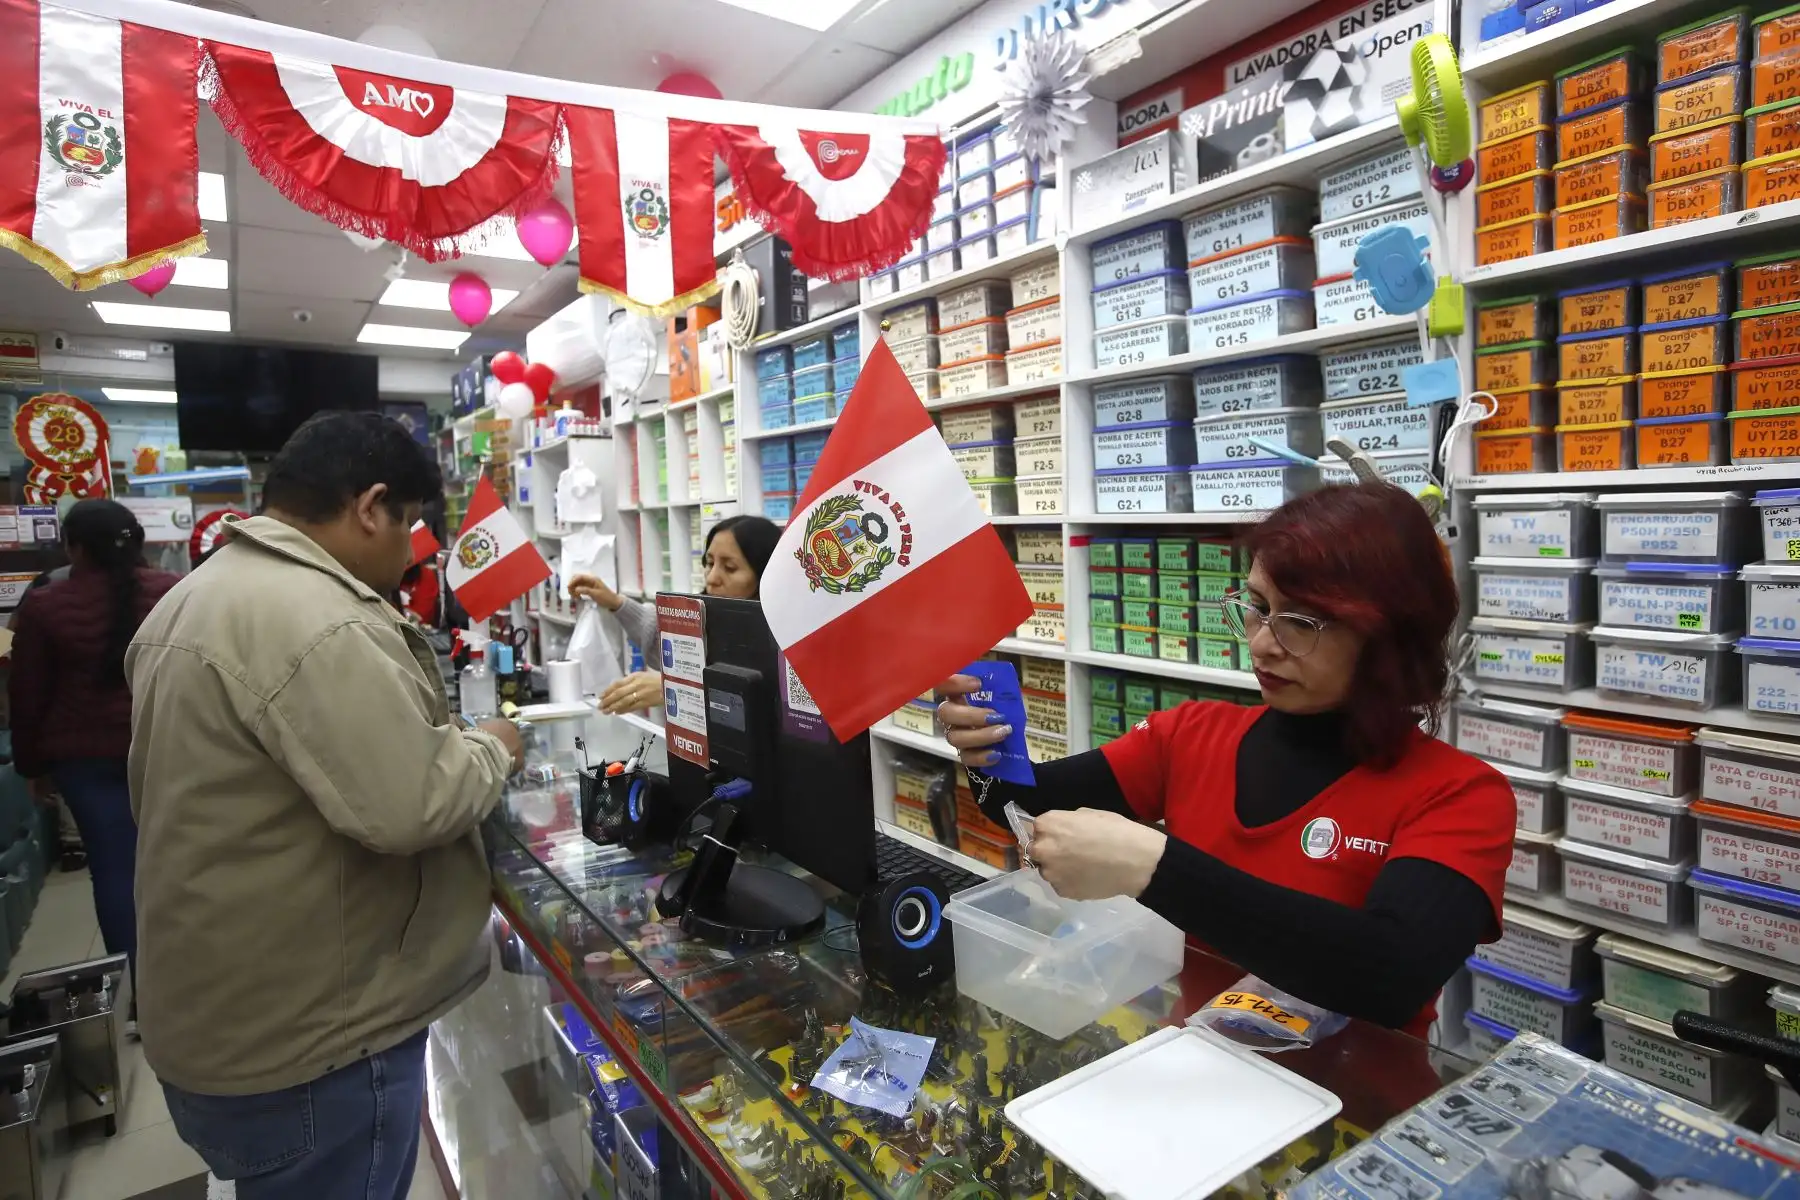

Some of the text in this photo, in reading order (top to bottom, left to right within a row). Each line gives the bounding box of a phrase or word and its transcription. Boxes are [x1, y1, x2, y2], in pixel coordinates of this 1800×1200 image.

[1233, 29, 1332, 84] LAVADORA
[1339, 10, 1366, 39] EN
[1361, 22, 1422, 58] Open
[58, 99, 115, 119] VIVA EL
[1675, 92, 1714, 112] DBX1
[1668, 106, 1722, 130] #10/70
[1487, 118, 1535, 139] #20/125
[1574, 124, 1607, 142] DBX1
[1492, 151, 1522, 167] DBX1
[1327, 164, 1376, 187] RESORTES
[1660, 157, 1722, 181] #18/110
[631, 179, 651, 189] VIVA
[1352, 184, 1390, 209] G1-2
[1667, 195, 1705, 212] DBX1
[1240, 197, 1270, 213] RECTA
[1194, 210, 1264, 239] JUKI SUN STAR
[1322, 206, 1429, 240] GUIA HILO VARIOS
[1569, 218, 1602, 234] DBX1
[1213, 233, 1243, 253] G1-1
[1214, 249, 1273, 272] VARIOS RECTA
[1115, 262, 1140, 280] G1-4
[1196, 261, 1270, 286] TORNILLO CARTER
[1030, 285, 1047, 299] F1-5
[1217, 281, 1249, 299] G1-3
[1326, 285, 1353, 298] GUIA
[1662, 281, 1701, 293] Orange
[1116, 307, 1142, 322] G1-8
[1655, 307, 1707, 322] #14/90
[1140, 325, 1163, 335] RECTA
[1215, 318, 1255, 332] BORDADO
[1571, 318, 1614, 331] #12/80
[1216, 332, 1248, 348] G1-5
[1658, 332, 1697, 343] Orange
[1664, 343, 1690, 354] B27
[1119, 351, 1145, 365] G1-9
[1326, 353, 1368, 367] LEVANTA
[1381, 361, 1394, 369] DE
[1648, 357, 1708, 372] #16/100
[1197, 366, 1278, 386] GUIADORES RECTA
[1570, 366, 1614, 379] #11/75
[1358, 374, 1399, 391] G2-2
[1657, 378, 1696, 389] Orange
[1749, 382, 1769, 395] UY
[1200, 384, 1234, 397] AROS DE
[1664, 390, 1689, 401] B27
[1222, 398, 1252, 413] G2-7
[1648, 404, 1706, 417] #21/130
[1117, 410, 1142, 423] G2-8
[1327, 407, 1376, 420] SOPORTE
[1565, 414, 1616, 424] #18/110
[1033, 421, 1053, 432] F2-7
[1200, 417, 1286, 433] PERILLA DE PUNTADA
[1751, 419, 1795, 428] Orange
[50, 425, 81, 443] 28
[959, 431, 974, 441] F2-1
[1135, 431, 1162, 439] ACEITE
[1654, 426, 1692, 436] Orange
[1747, 430, 1797, 442] UY128
[1358, 434, 1399, 450] G2-4
[1660, 437, 1685, 448] B27
[1226, 444, 1257, 458] G2-9
[1580, 445, 1603, 455] B27
[1034, 461, 1054, 470] F2-5
[1117, 453, 1142, 465] G2-3
[1657, 453, 1689, 464] #7-8
[1140, 474, 1164, 482] RECTA
[1196, 469, 1281, 481] PALANCA ATRAQUE
[1138, 485, 1163, 493] AGUJA
[853, 480, 889, 504] VIVA
[890, 502, 905, 522] EL
[1036, 501, 1056, 511] F2-8
[1117, 500, 1142, 510] G2-1
[1221, 494, 1253, 506] G2-6
[1511, 518, 1536, 530] TW
[1621, 527, 1701, 536] P50H P950
[1488, 534, 1512, 544] 211
[1641, 540, 1678, 550] P952
[1034, 553, 1055, 563] F3-4
[1035, 592, 1056, 603] F4-5
[1606, 585, 1706, 598] PATITA CIERRE
[1609, 597, 1707, 612] P36LN-P36N
[1634, 613, 1673, 624] P363
[1755, 616, 1795, 631] 210
[1034, 627, 1055, 637] F3-9
[1506, 648, 1532, 661] TW
[1635, 653, 1665, 666] TW
[1604, 665, 1700, 684] 212 213 214
[1039, 680, 1060, 691] F4-2
[1659, 684, 1697, 696] CR3/8
[1758, 687, 1786, 698] 222
[673, 735, 703, 755] VENETO
[1578, 738, 1615, 749] PATITA
[1622, 754, 1665, 768] MT18B
[1710, 762, 1742, 777] PATA
[1715, 776, 1751, 790] SP18
[1750, 795, 1778, 811] 1/4
[1572, 802, 1666, 829] PATA C/GUIADOR
[1577, 814, 1659, 839] SP18 SP18L
[1706, 834, 1738, 848] PATA
[1712, 847, 1748, 862] SP18
[1569, 866, 1664, 896] PATA C/GUIADOR
[1741, 867, 1782, 885] 1/32
[1571, 879, 1662, 907] SP18 SP18L
[1599, 897, 1631, 912] 5/16
[1704, 902, 1735, 918] PATA
[1716, 917, 1749, 932] SP18
[1741, 934, 1776, 951] 3/16
[1611, 1040, 1706, 1080] COMPENSACION
[1620, 1054, 1694, 1088] 210 220L
